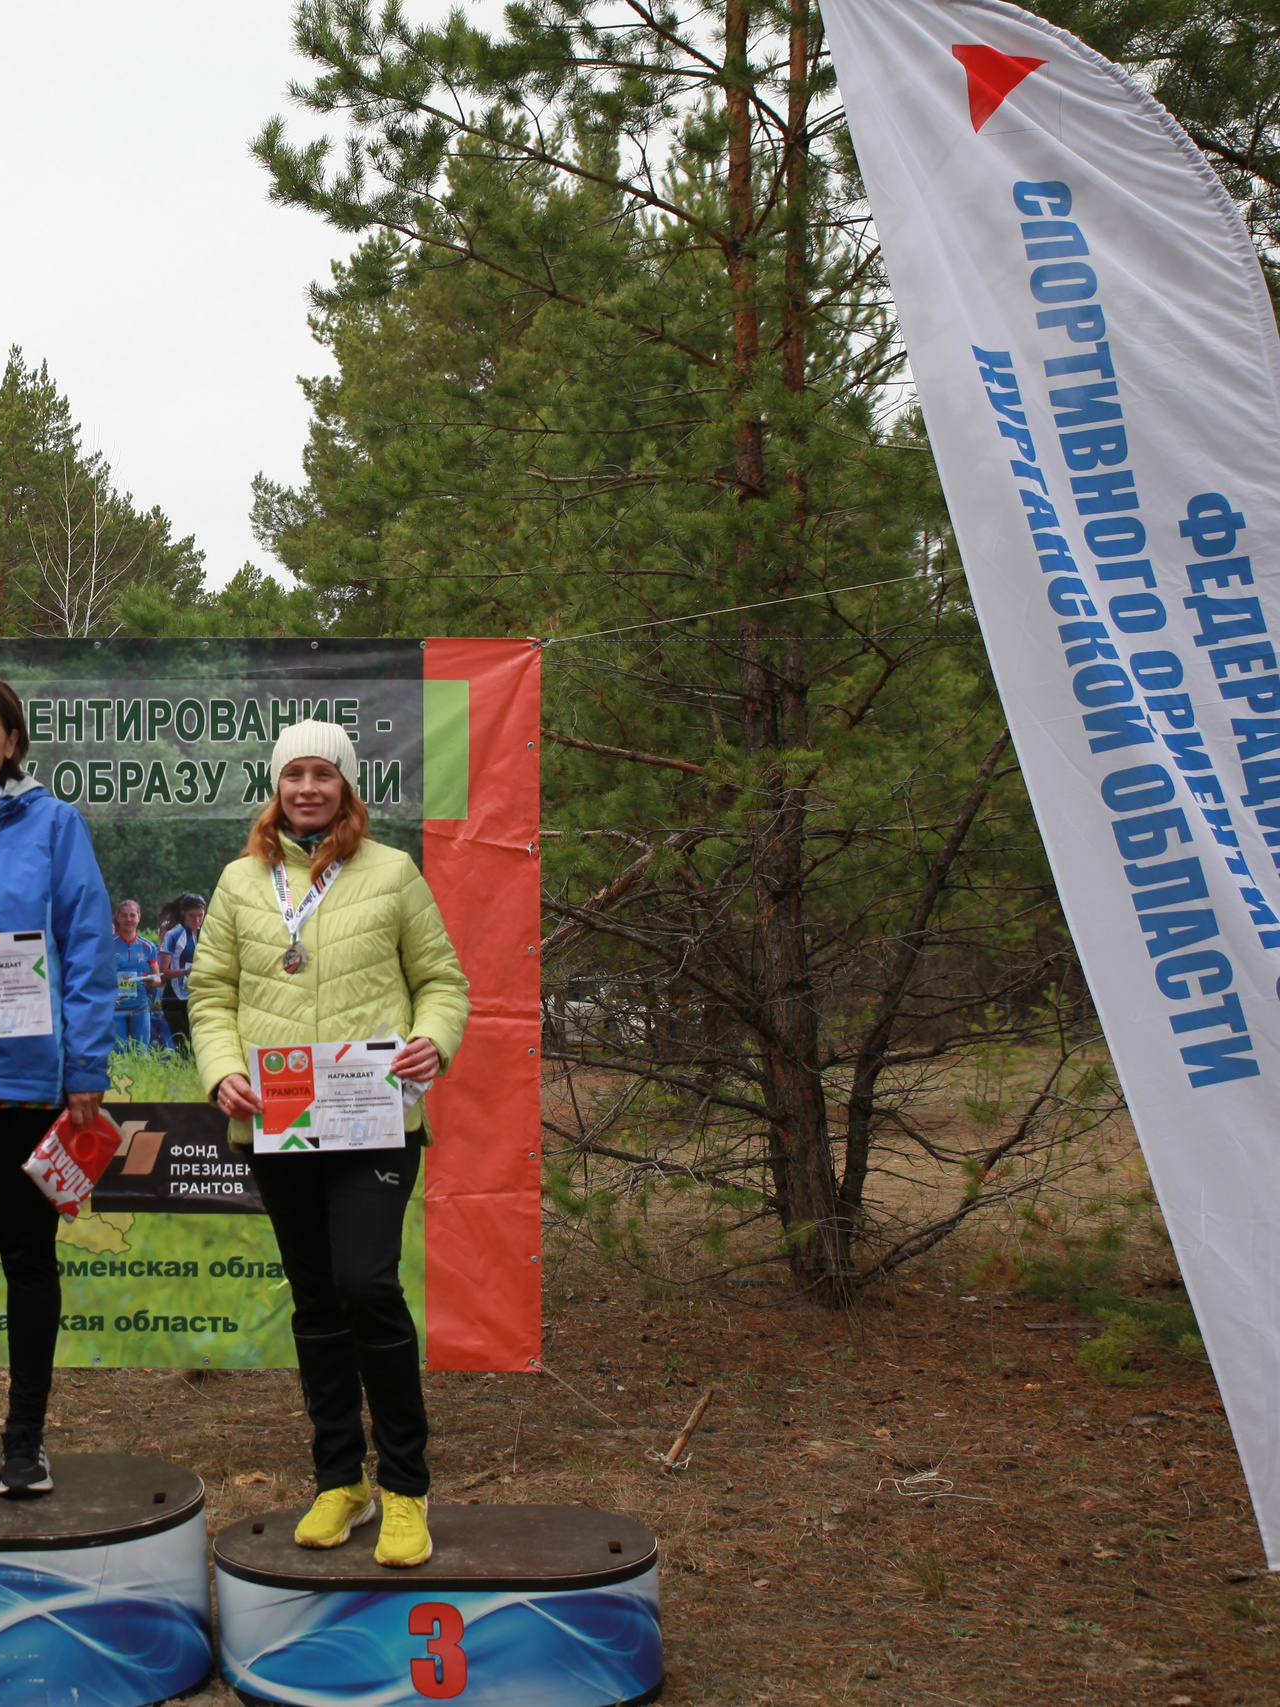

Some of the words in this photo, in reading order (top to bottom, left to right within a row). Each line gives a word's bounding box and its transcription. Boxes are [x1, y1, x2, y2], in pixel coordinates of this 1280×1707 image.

[1013, 180, 1167, 634] СПОРТИВНОГО
[1129, 650, 1280, 1000] ОРИЕНТИ
[21, 698, 360, 743] ЕНТИРОВАНИЕ
[971, 344, 1159, 754] КУРГАНСКОЙ
[1101, 763, 1260, 1088] ОБЛАСТИ
[52, 760, 227, 805] ОБРАЗУ
[241, 760, 402, 804] ЖНИ
[327, 1071, 374, 1080] НАГРАЖДАЕТ
[266, 1086, 311, 1097] ГРАМОТА
[170, 1144, 219, 1159] ФОНД
[41, 1131, 95, 1198] AURALO
[170, 1163, 251, 1178] ПРЕЗИДЕН
[170, 1182, 244, 1195] ГРАНТОВ
[56, 1259, 199, 1278] менская
[209, 1256, 283, 1278] обла
[114, 1309, 239, 1333] область
[408, 1601, 468, 1699] 3
